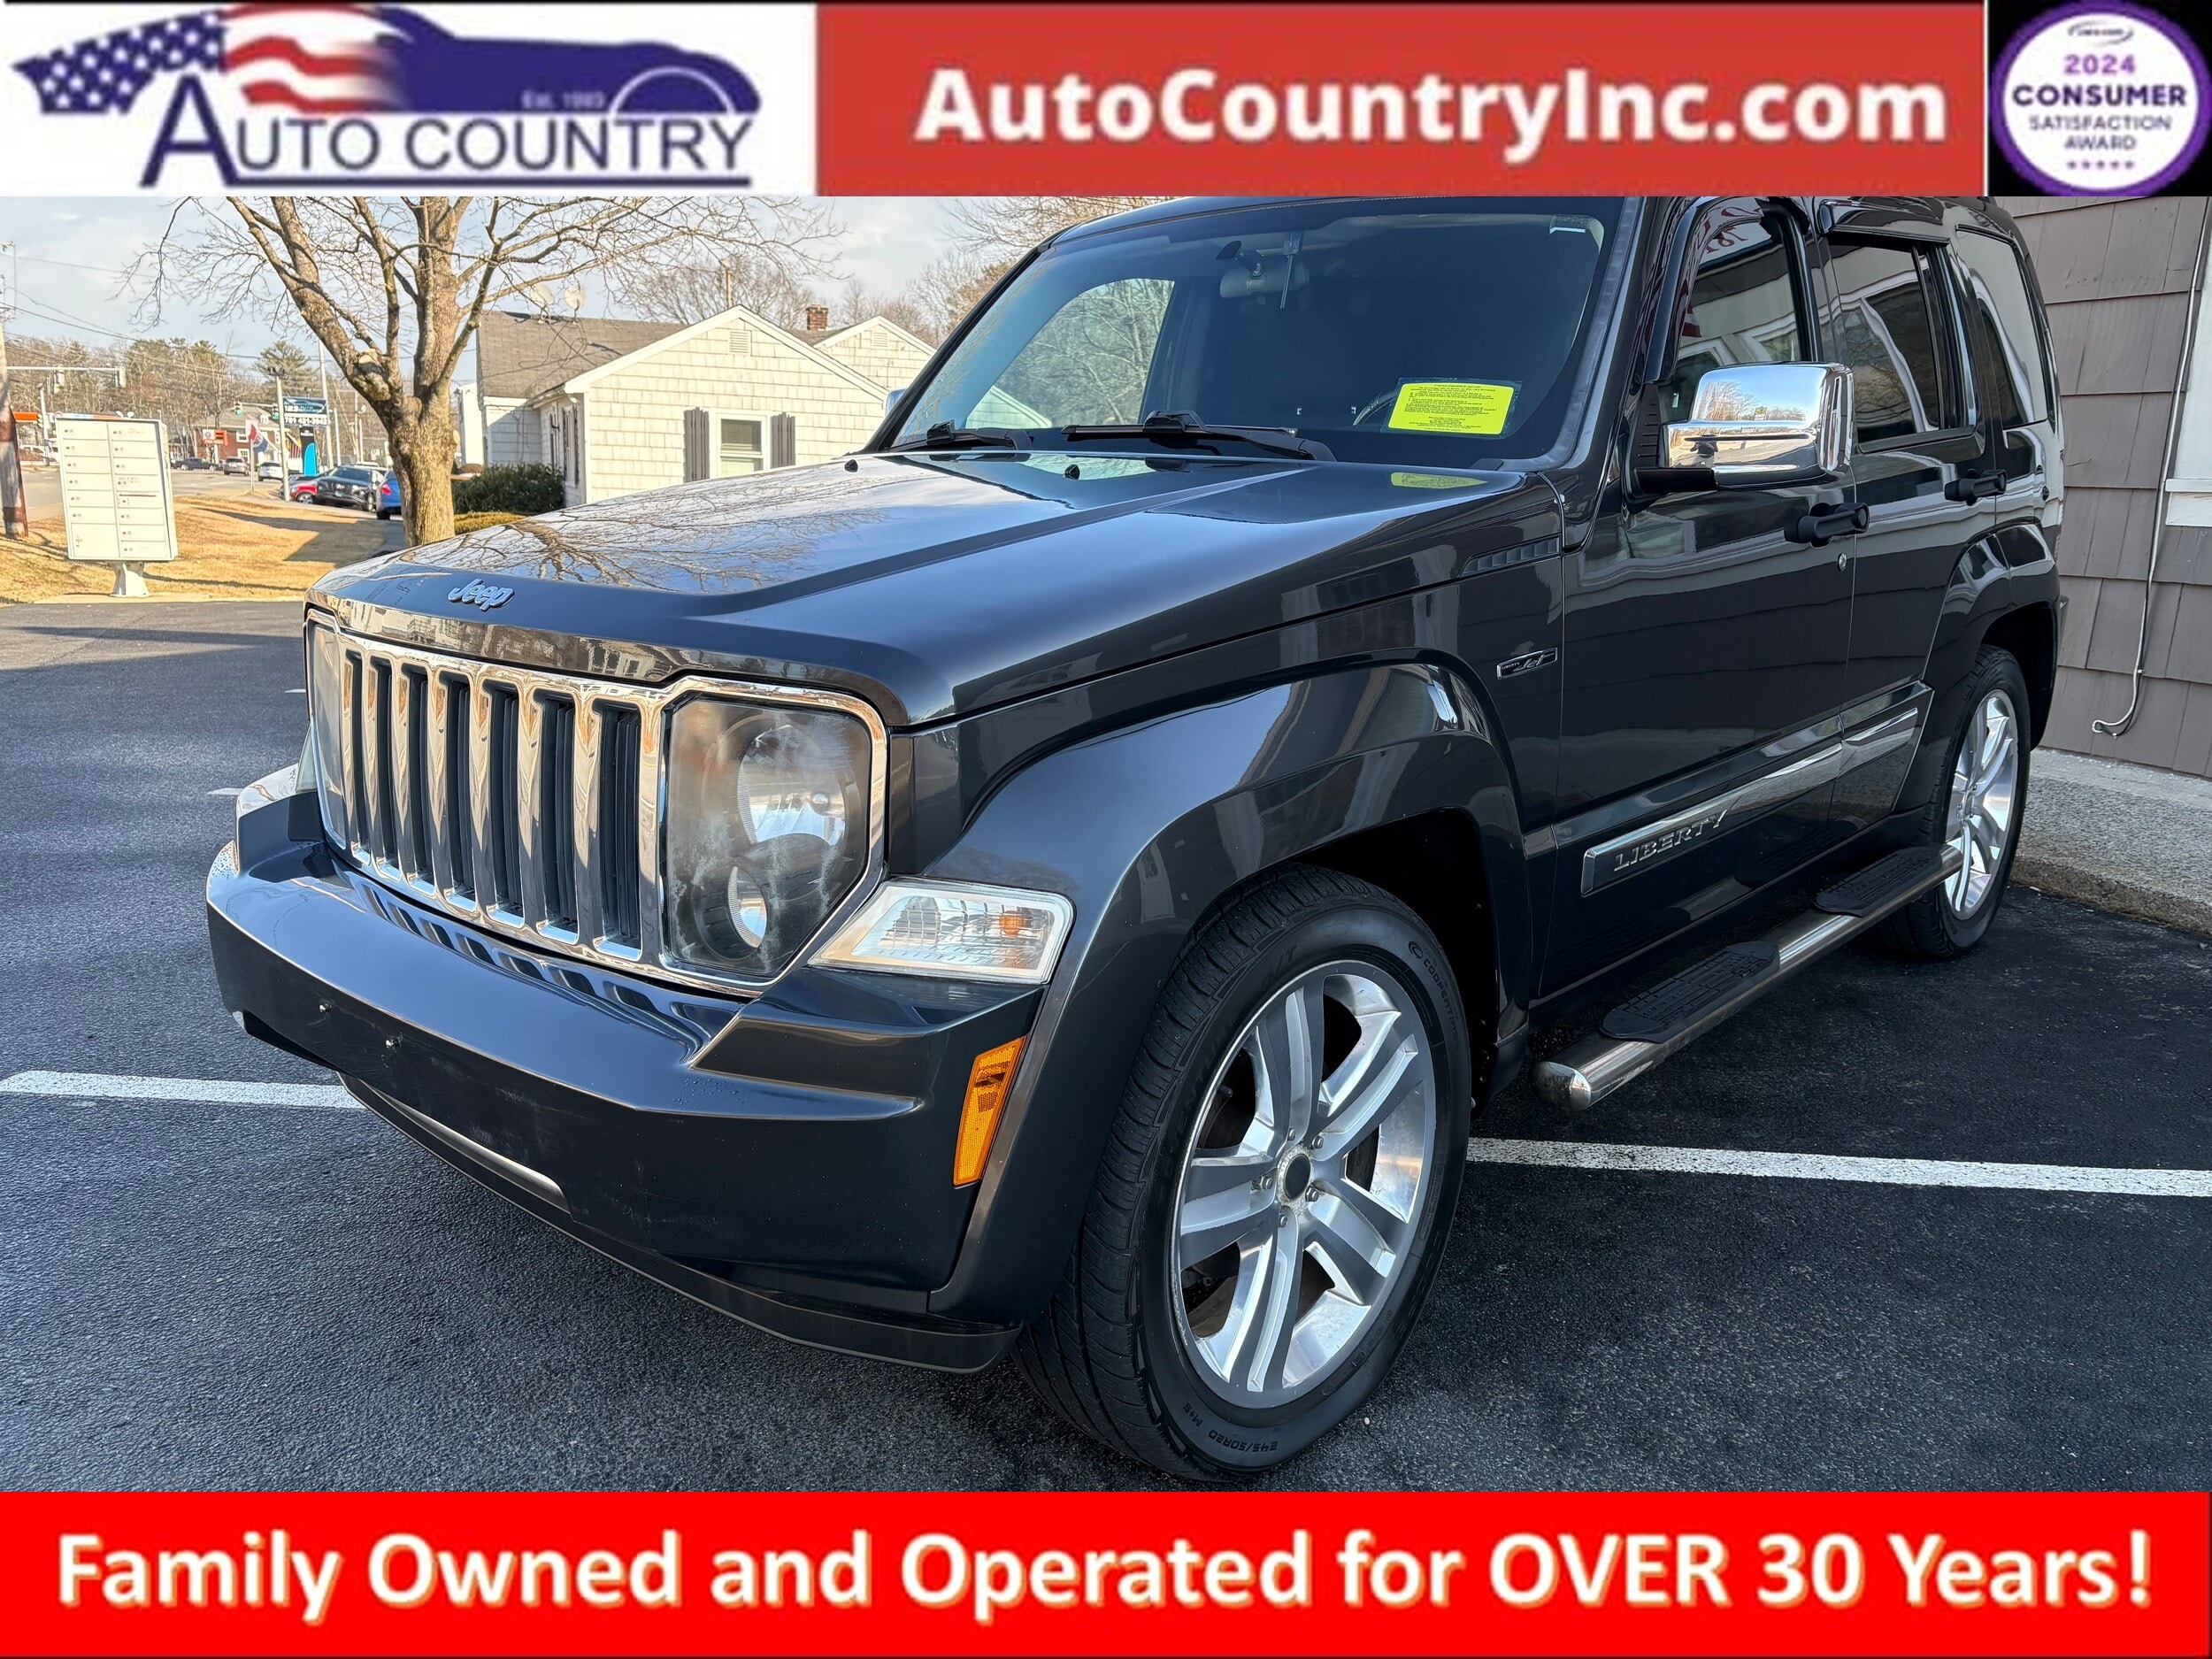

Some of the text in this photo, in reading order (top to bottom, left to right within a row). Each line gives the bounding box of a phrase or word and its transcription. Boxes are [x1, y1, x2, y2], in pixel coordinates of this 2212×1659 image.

[448, 578, 515, 611] Jeep
[1502, 653, 1555, 672] LIBERTY Jet
[1614, 809, 1728, 872] LIBERTY
[1183, 1402, 1279, 1453] 245/50R20 M+S
